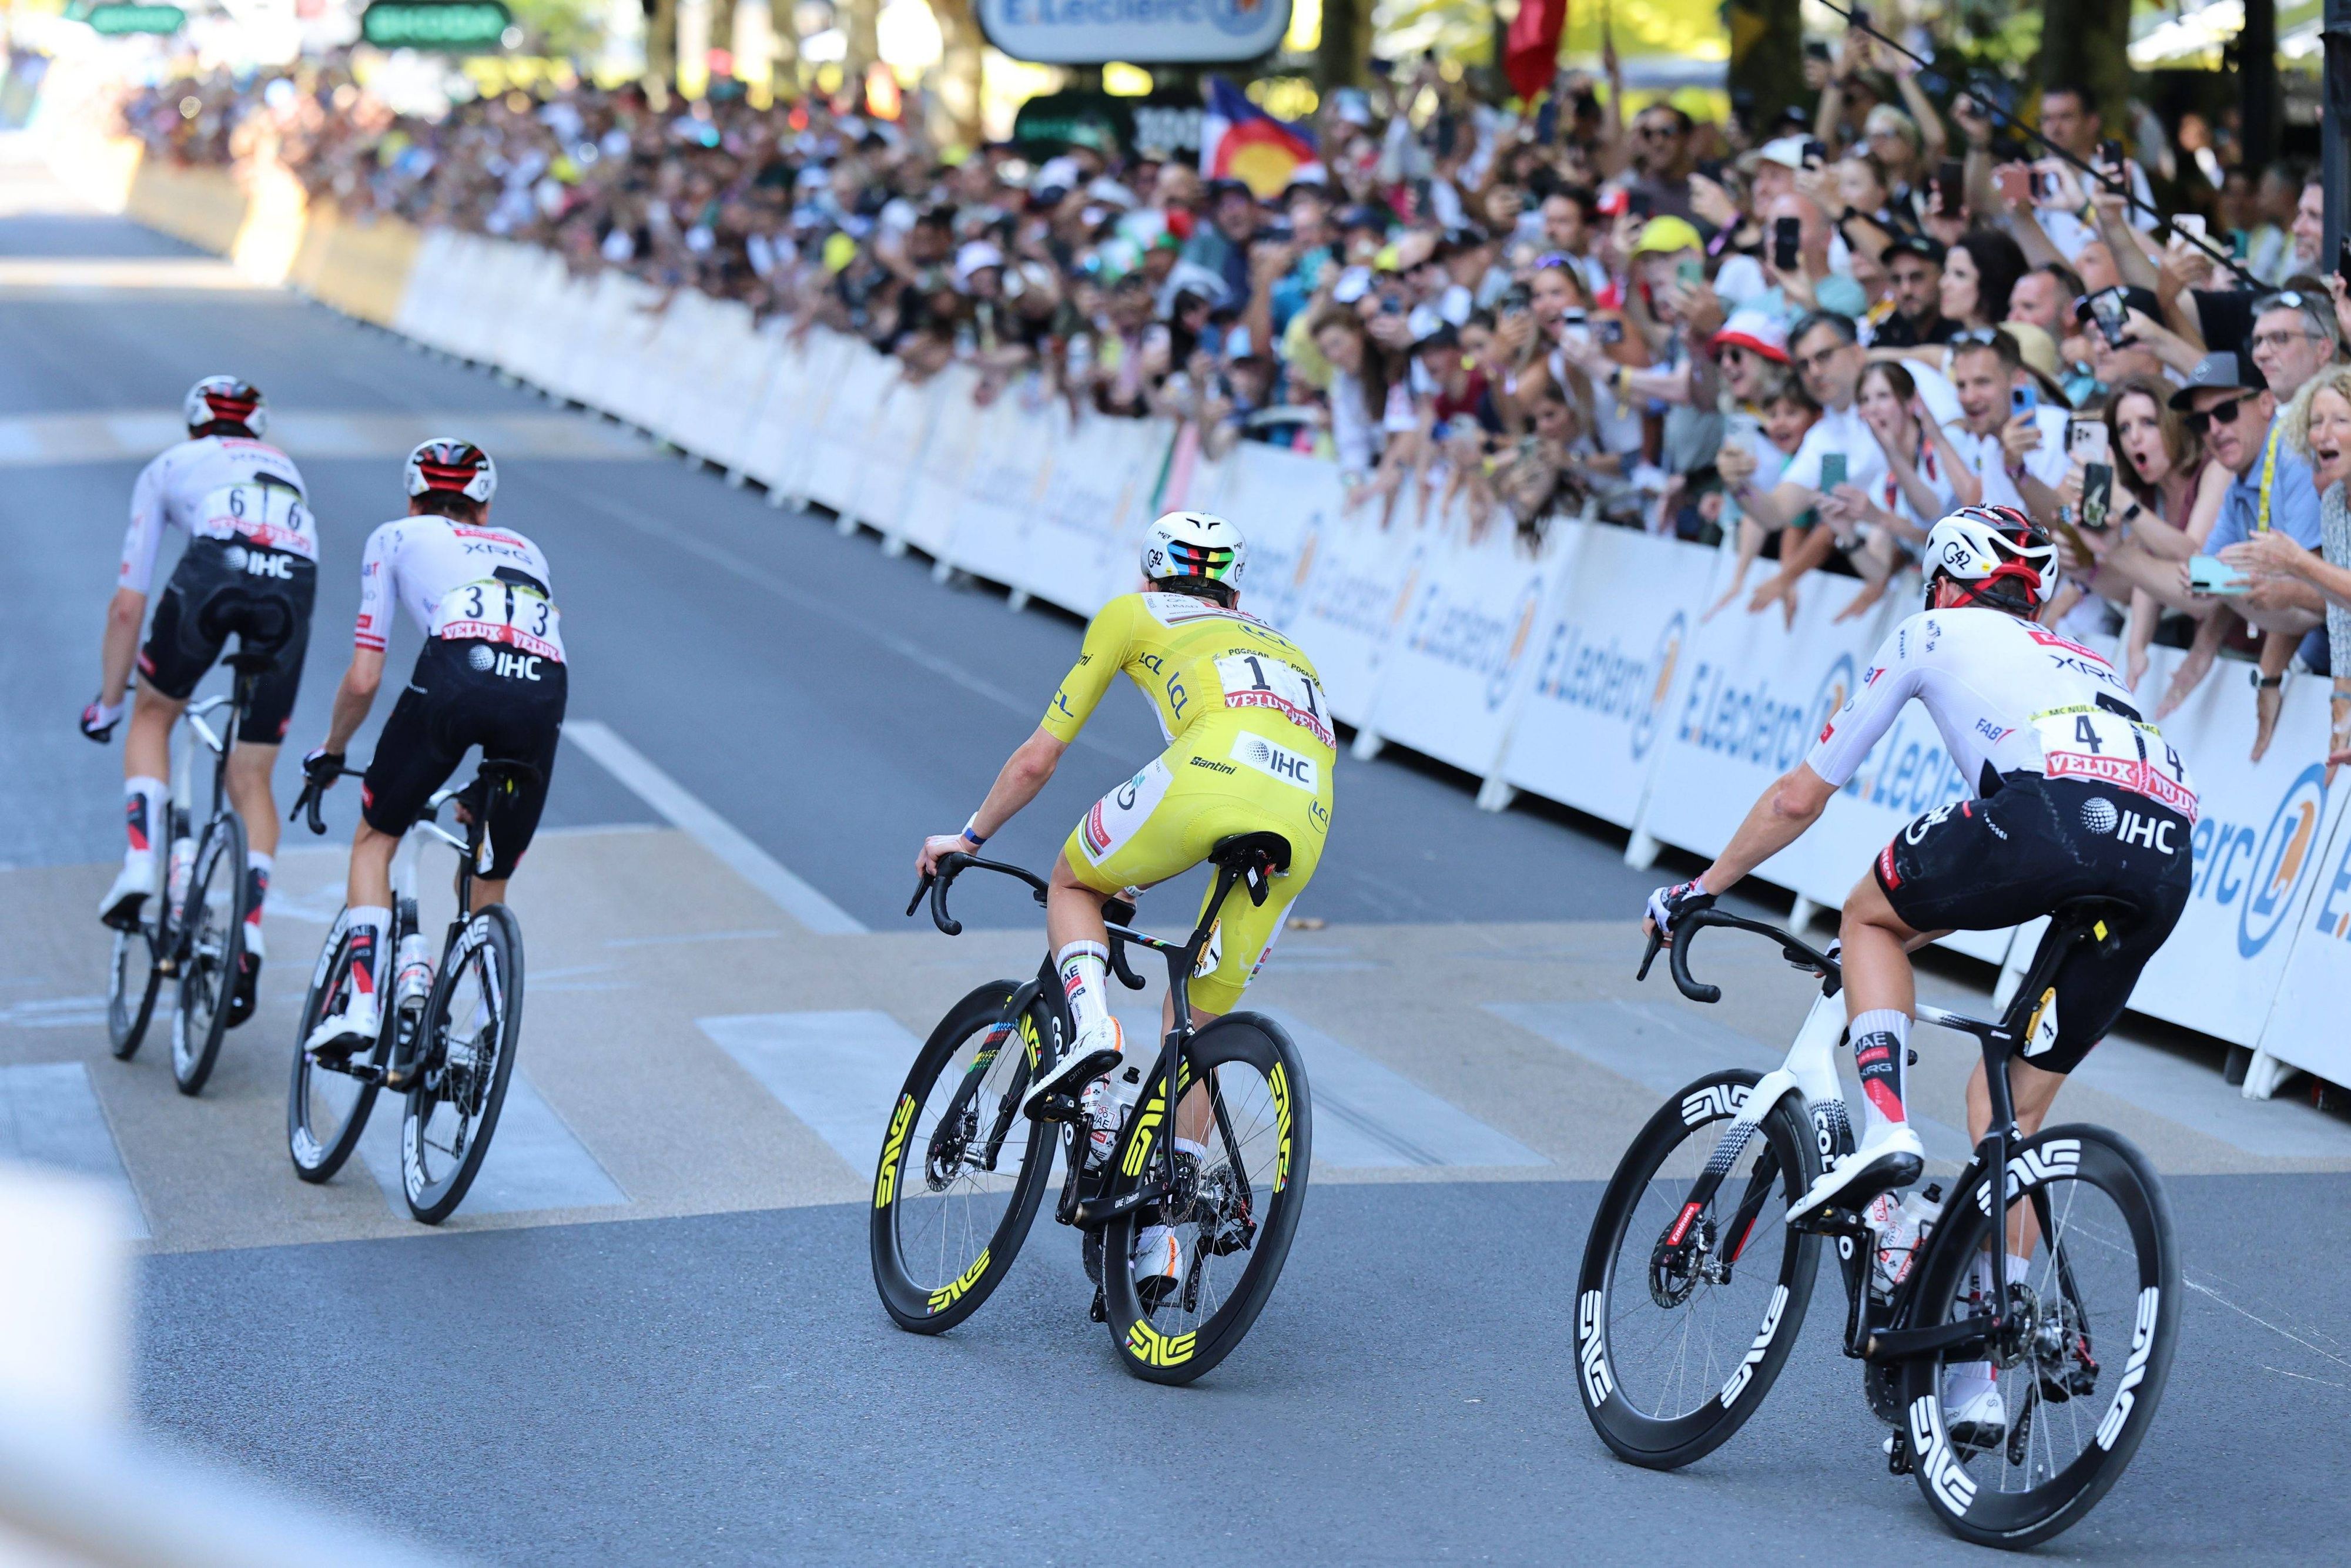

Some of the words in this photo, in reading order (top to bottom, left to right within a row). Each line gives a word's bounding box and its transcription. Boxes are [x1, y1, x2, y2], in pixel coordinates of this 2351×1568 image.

[229, 488, 244, 518] 6
[287, 502, 302, 530] 6
[1157, 531, 1172, 540] MET
[247, 550, 294, 579] IHC
[1147, 549, 1164, 568] G42
[1943, 541, 1971, 570] G42
[465, 586, 484, 618] 3
[533, 602, 548, 636] 3
[443, 624, 500, 642] VELUX
[495, 652, 541, 687] IHC
[1138, 652, 1164, 676] LCL
[1166, 671, 1187, 720] LCL
[1244, 656, 1271, 691] 1
[1301, 678, 1319, 719] 1
[1679, 663, 1806, 772] E.Leclerc
[2075, 715, 2102, 753] 4
[2166, 744, 2184, 783] 4
[1190, 756, 1238, 776] Santini
[1270, 749, 1310, 784] IHC
[2048, 754, 2134, 783] VELUX
[2116, 809, 2176, 855] IHC
[1209, 947, 1220, 966] 1
[1114, 1198, 1125, 1208] UAE
[1672, 1205, 1696, 1243] Emirates
